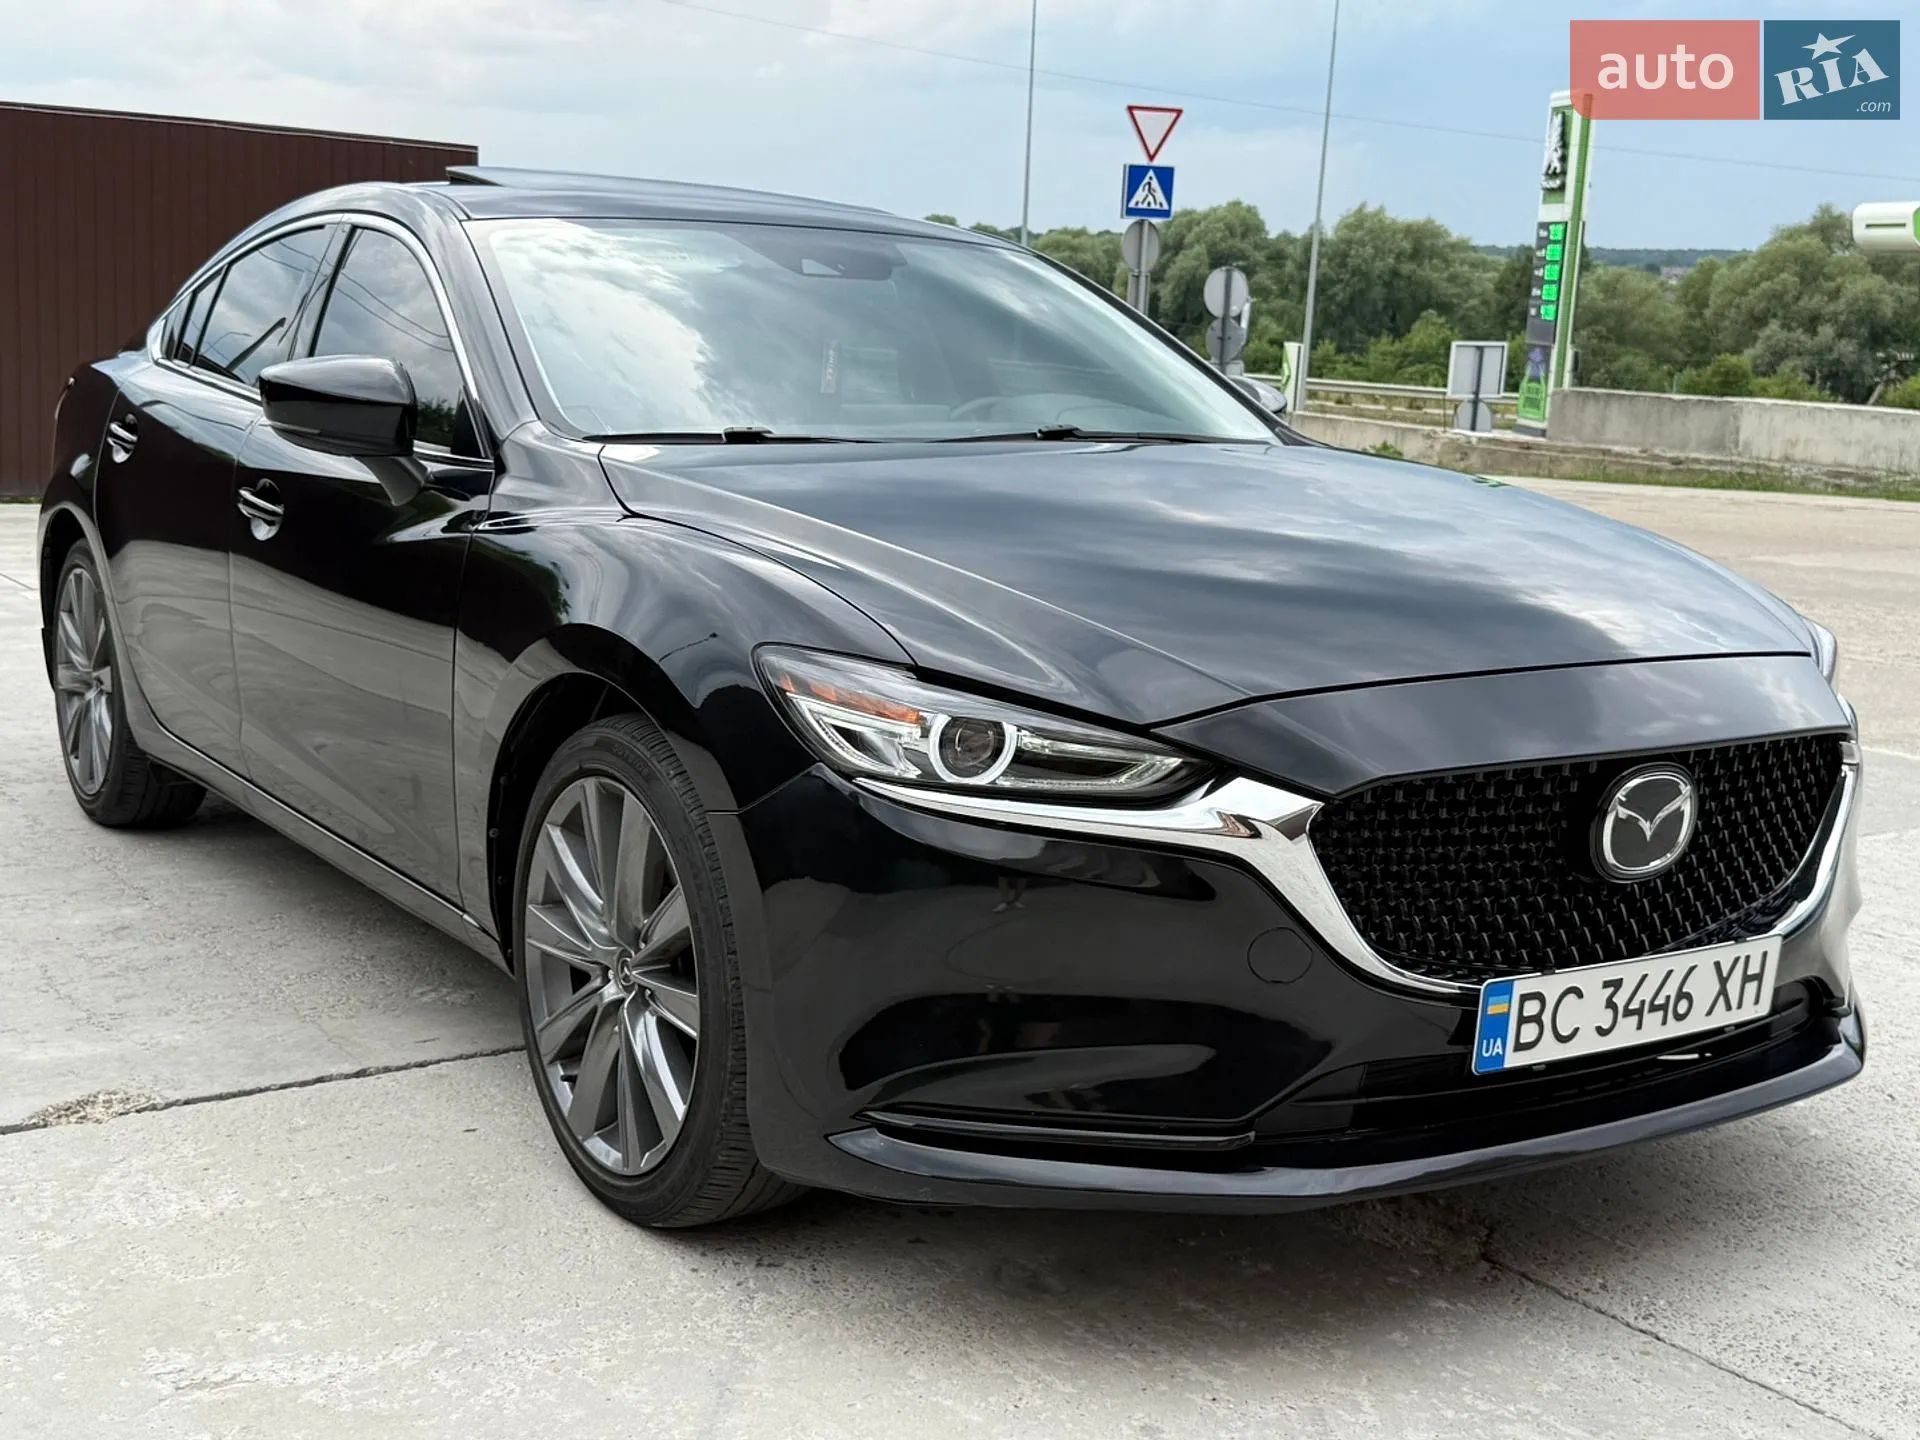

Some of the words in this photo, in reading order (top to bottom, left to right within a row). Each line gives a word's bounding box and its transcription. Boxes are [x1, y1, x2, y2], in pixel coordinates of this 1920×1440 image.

[1512, 985, 1585, 1053] BC
[1594, 963, 1699, 1037] 3446
[1704, 950, 1769, 1018] XH
[1481, 1038, 1504, 1058] UA
